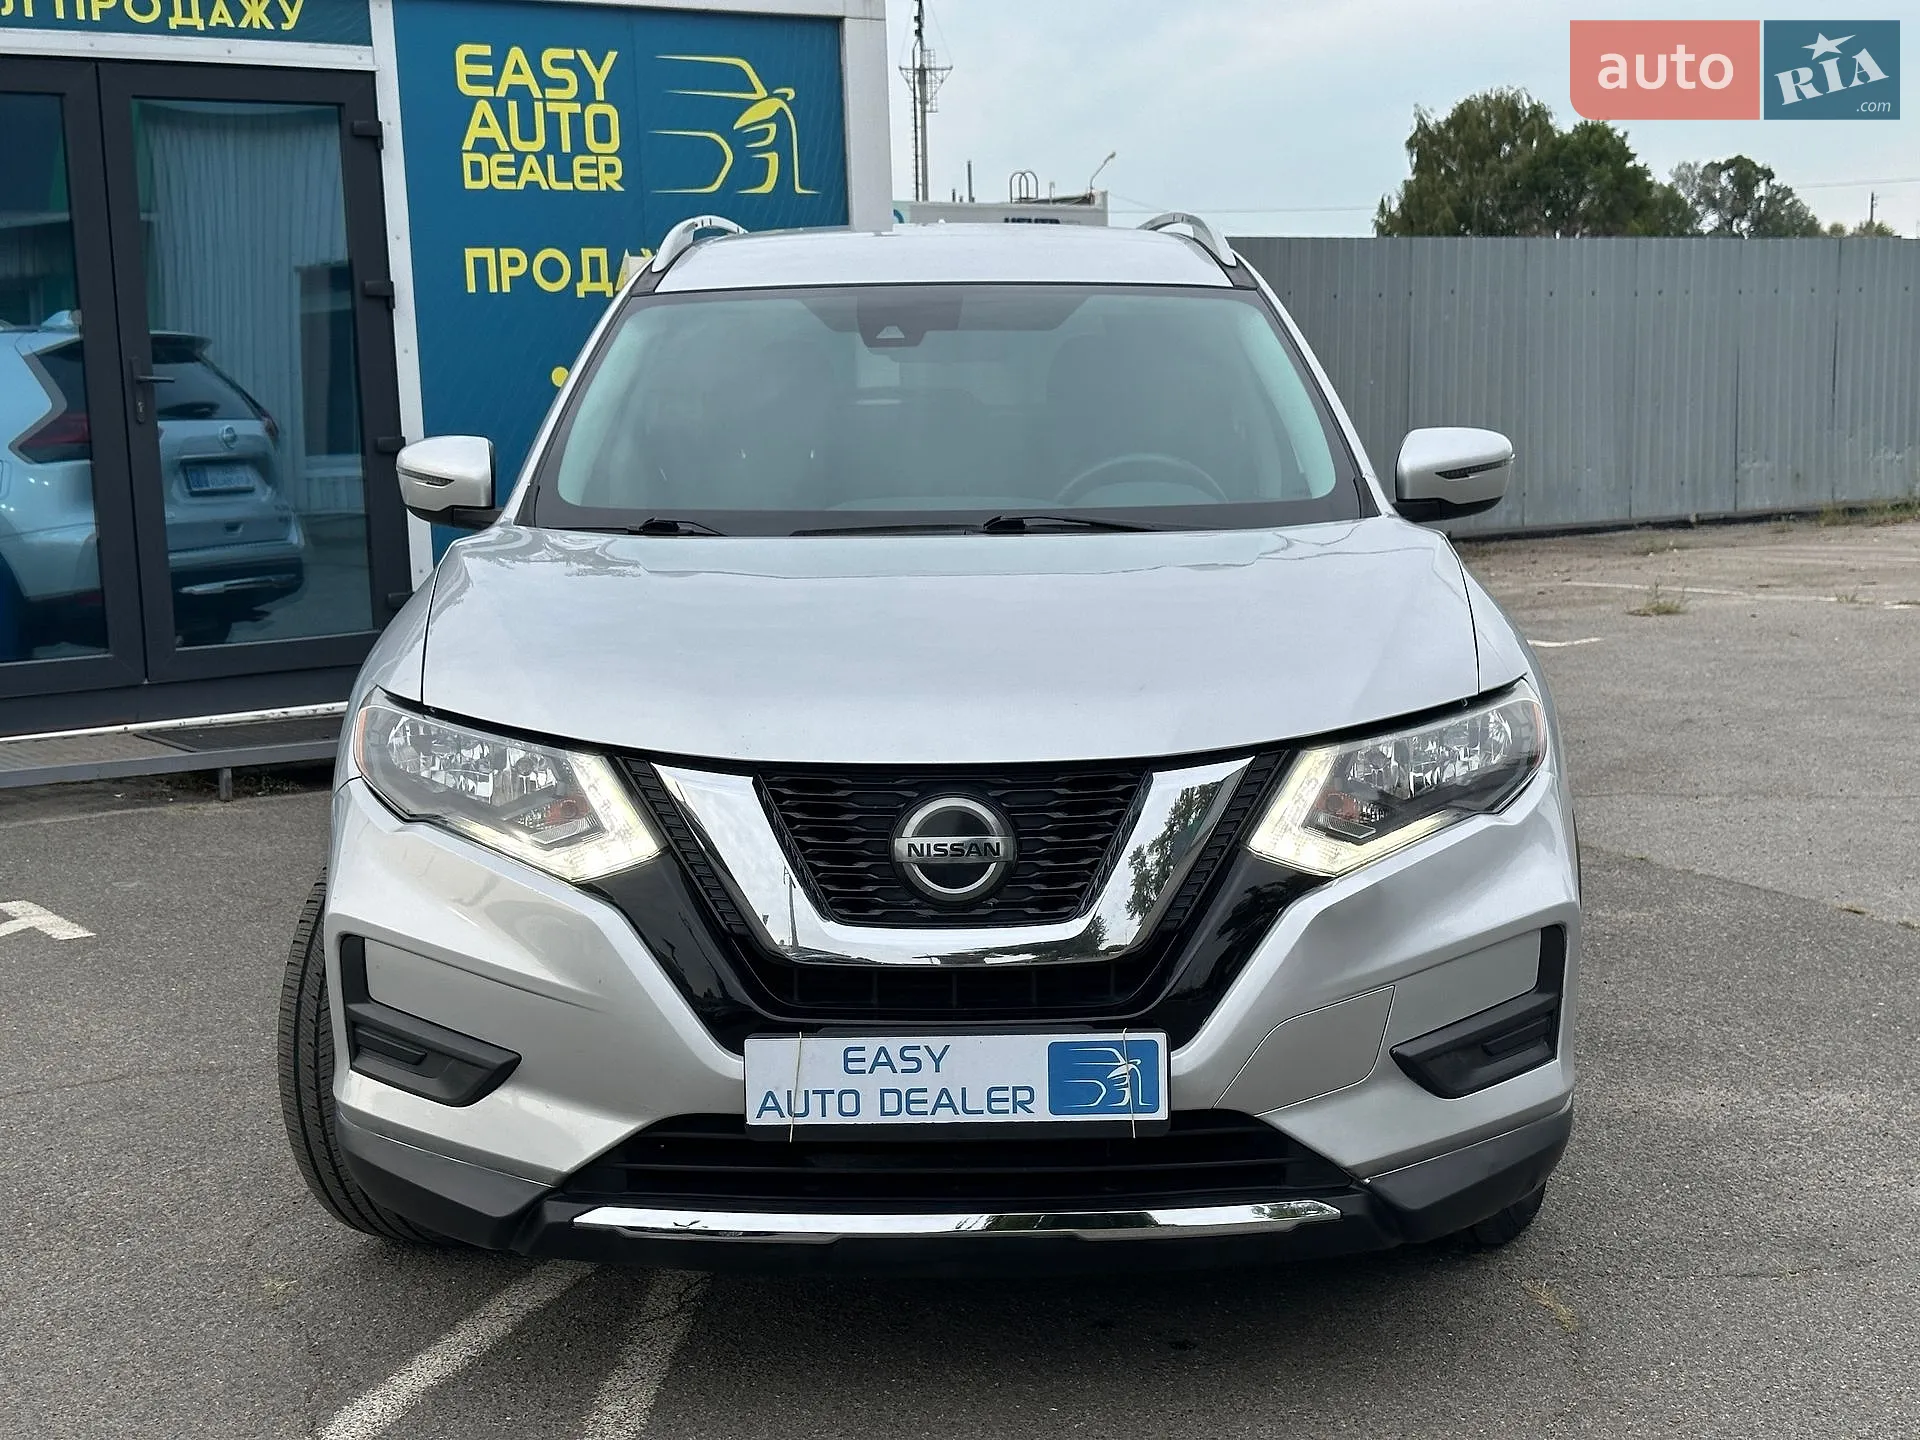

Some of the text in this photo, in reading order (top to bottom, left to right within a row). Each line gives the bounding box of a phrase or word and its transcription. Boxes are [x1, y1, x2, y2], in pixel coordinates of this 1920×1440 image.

[455, 44, 618, 101] EASY
[461, 99, 621, 154] AUTO
[462, 152, 625, 192] DEALER
[906, 841, 1001, 858] NISSAN
[842, 1044, 951, 1075] EASY
[755, 1085, 1035, 1119] AUTO DEALER
